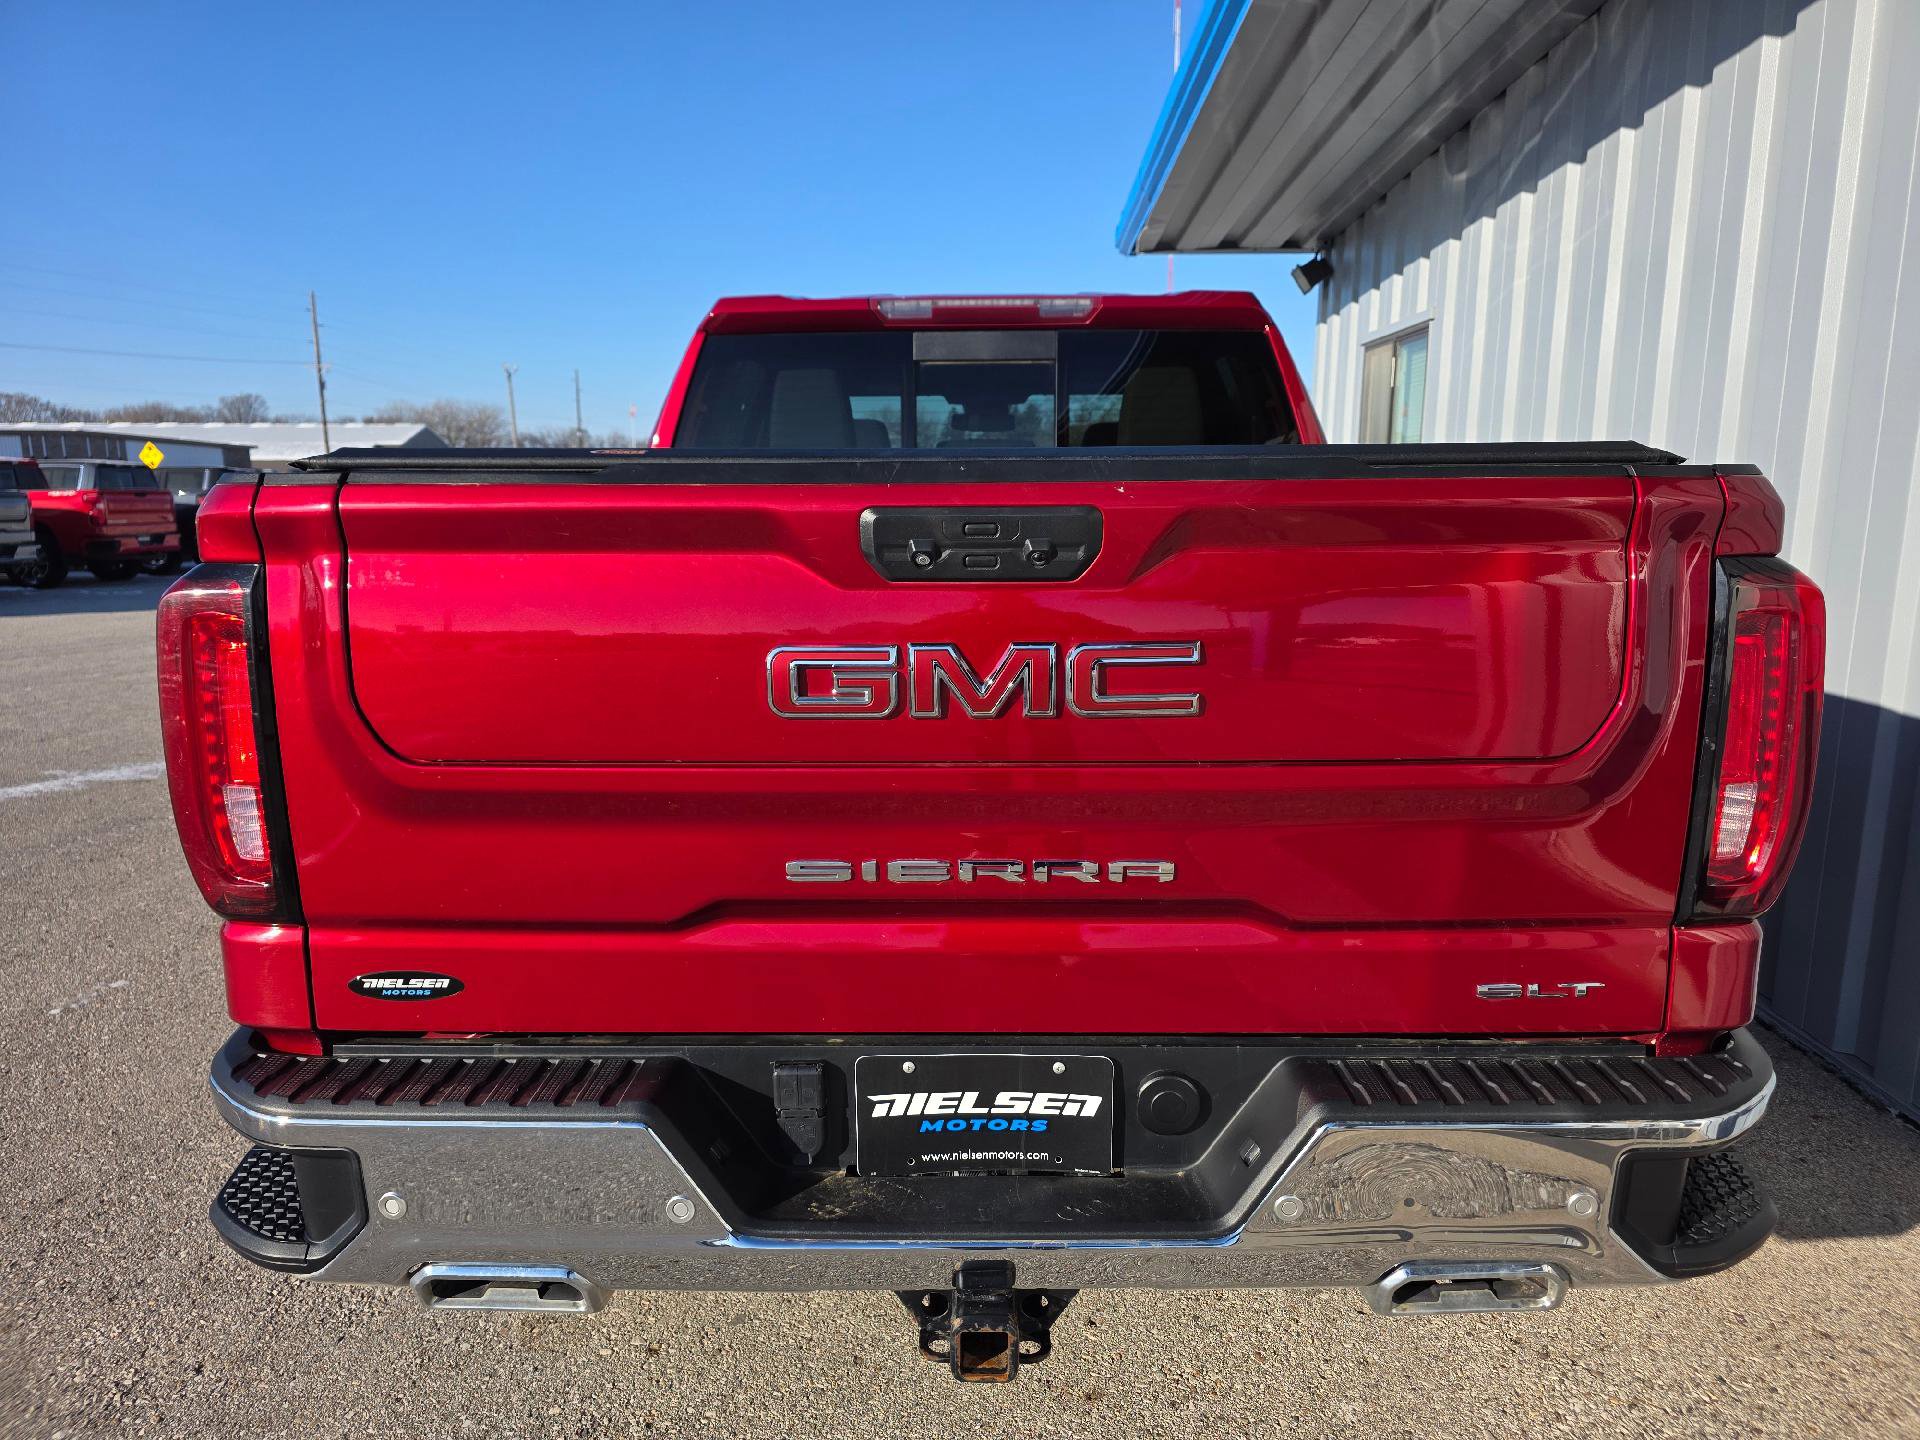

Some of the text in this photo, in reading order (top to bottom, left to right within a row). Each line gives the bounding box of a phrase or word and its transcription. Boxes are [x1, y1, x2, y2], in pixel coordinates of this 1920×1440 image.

[766, 641, 1202, 719] GMC
[785, 858, 1176, 883] SIERRA
[361, 978, 451, 988] NIELSEN
[1476, 982, 1606, 998] SLT
[867, 1091, 1103, 1118] NIELSEN
[919, 1118, 1048, 1133] MOTORS
[921, 1149, 1049, 1163] www.nielsenmotors.com
